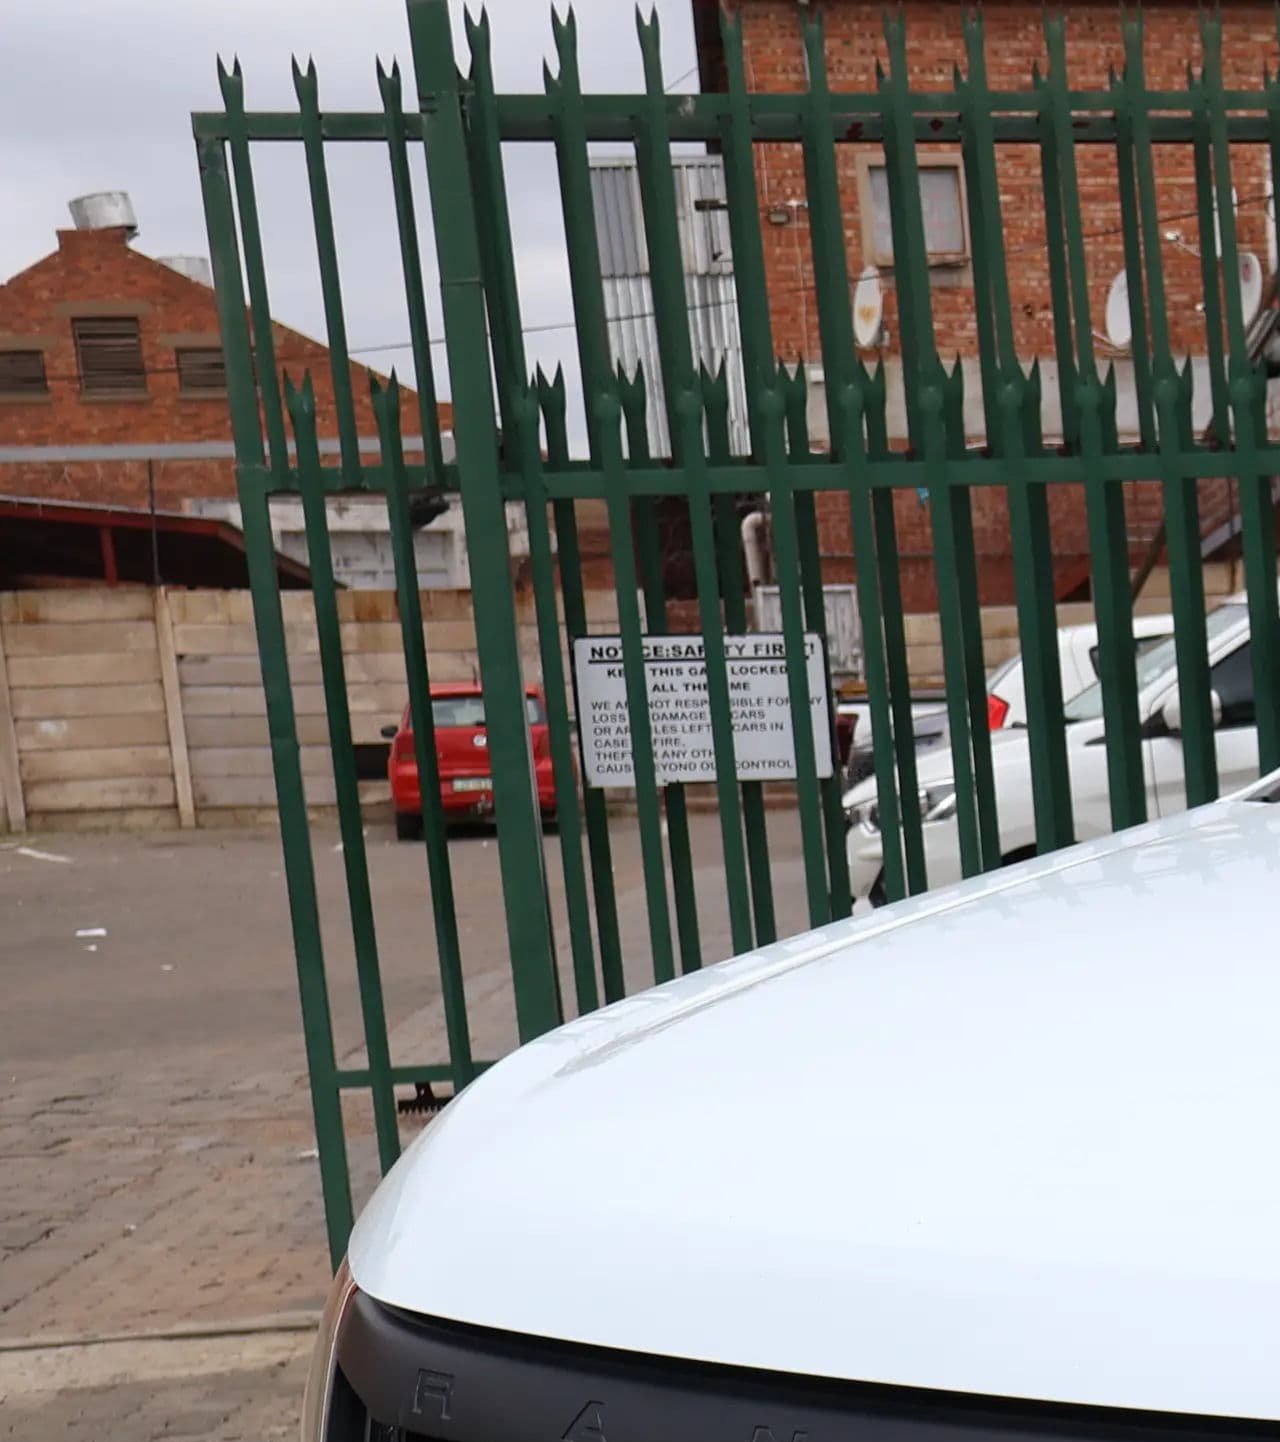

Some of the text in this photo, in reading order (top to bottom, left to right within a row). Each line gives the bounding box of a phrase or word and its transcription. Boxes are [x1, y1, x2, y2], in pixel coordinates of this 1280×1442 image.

[753, 642, 815, 657] FIR!
[649, 667, 683, 677] THIS
[730, 665, 788, 676] LOCKED
[652, 683, 678, 693] ALL
[591, 701, 610, 710] WE
[592, 709, 766, 724] LOSS DAMAGE CARS
[593, 727, 611, 736] OR
[681, 724, 712, 734] LEFT
[732, 722, 767, 733] CARS
[770, 722, 784, 732] IN
[594, 738, 629, 749] CASE
[661, 749, 688, 759] ANY
[596, 764, 632, 774] CAUS
